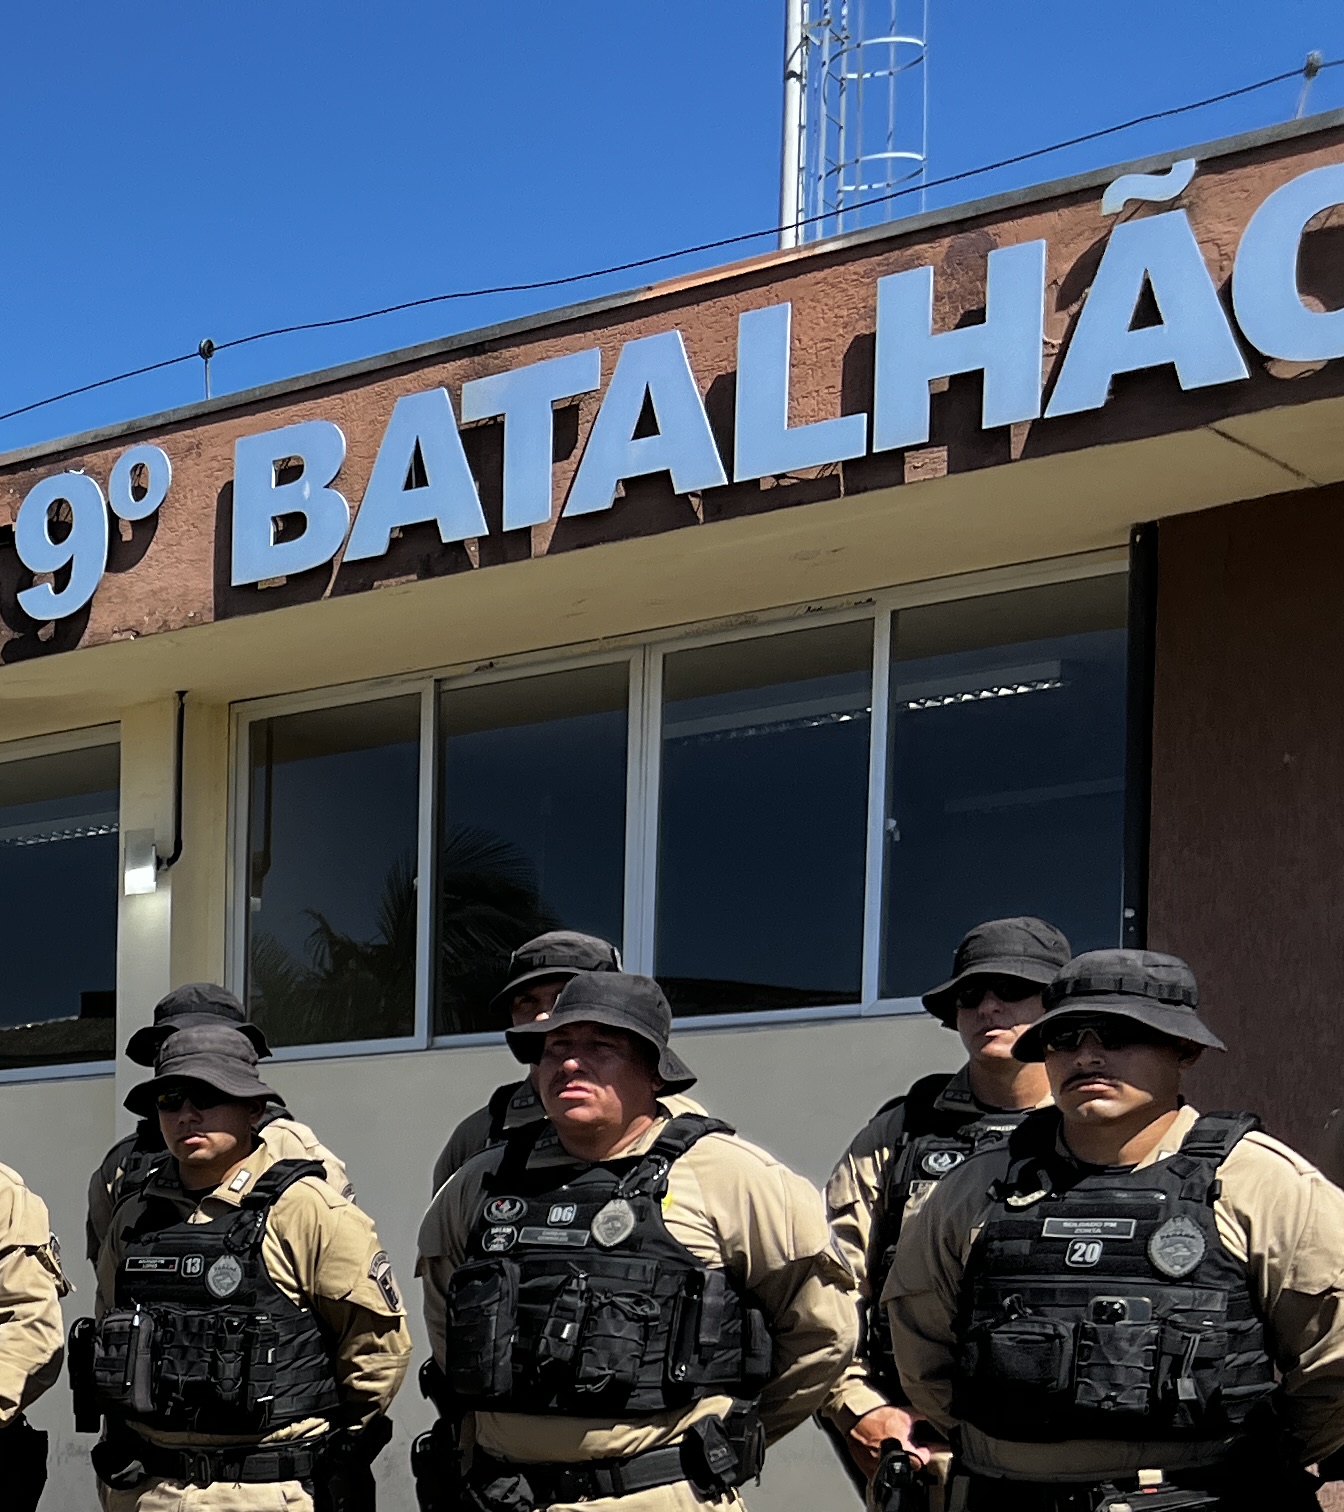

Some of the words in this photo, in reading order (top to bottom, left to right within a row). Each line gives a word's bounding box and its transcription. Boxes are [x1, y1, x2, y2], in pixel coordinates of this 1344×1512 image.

[549, 1206, 575, 1223] 06
[1070, 1242, 1100, 1262] 20
[185, 1258, 201, 1273] 13
